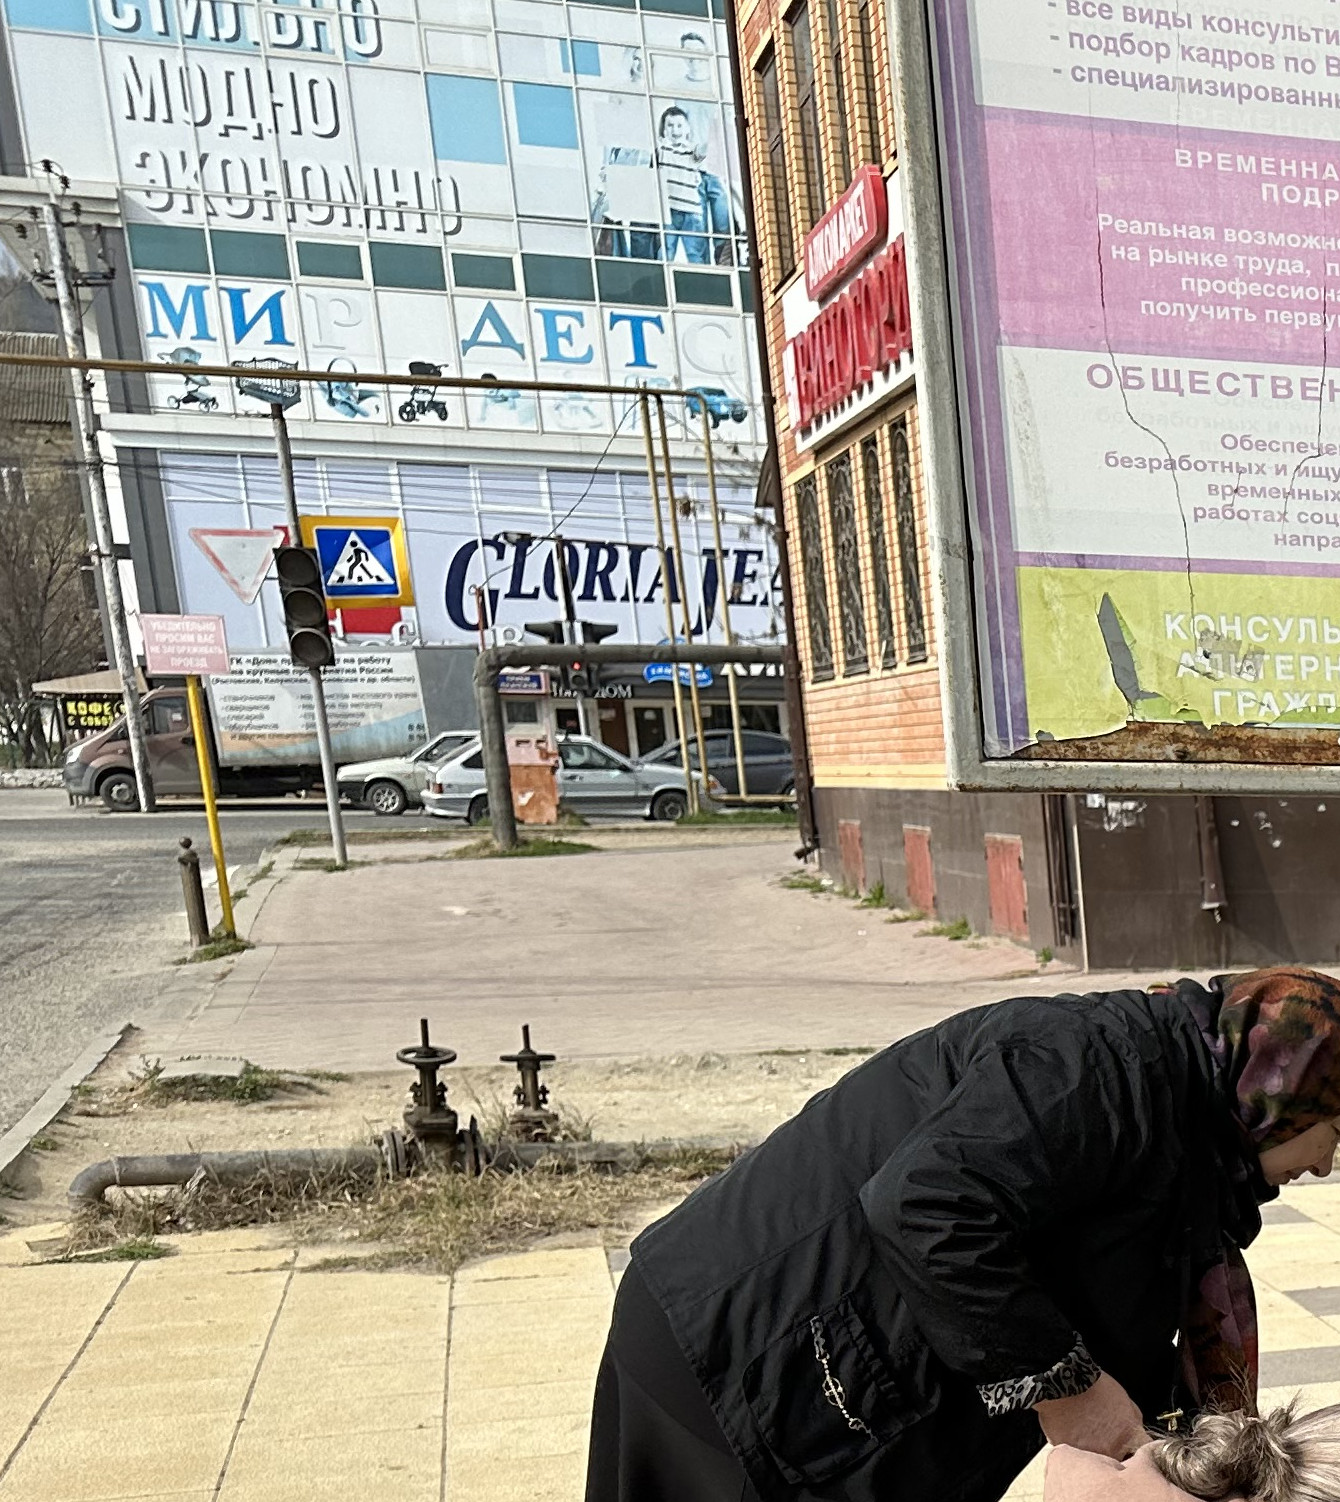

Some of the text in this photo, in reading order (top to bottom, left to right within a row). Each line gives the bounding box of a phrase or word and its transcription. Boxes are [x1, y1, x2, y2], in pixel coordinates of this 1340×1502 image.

[120, 54, 341, 140] МОДНО
[132, 150, 464, 237] ЭКОНОМНО
[1097, 213, 1214, 240] Реальная
[445, 534, 681, 631] GLORIA
[66, 700, 111, 716] КОФЕ
